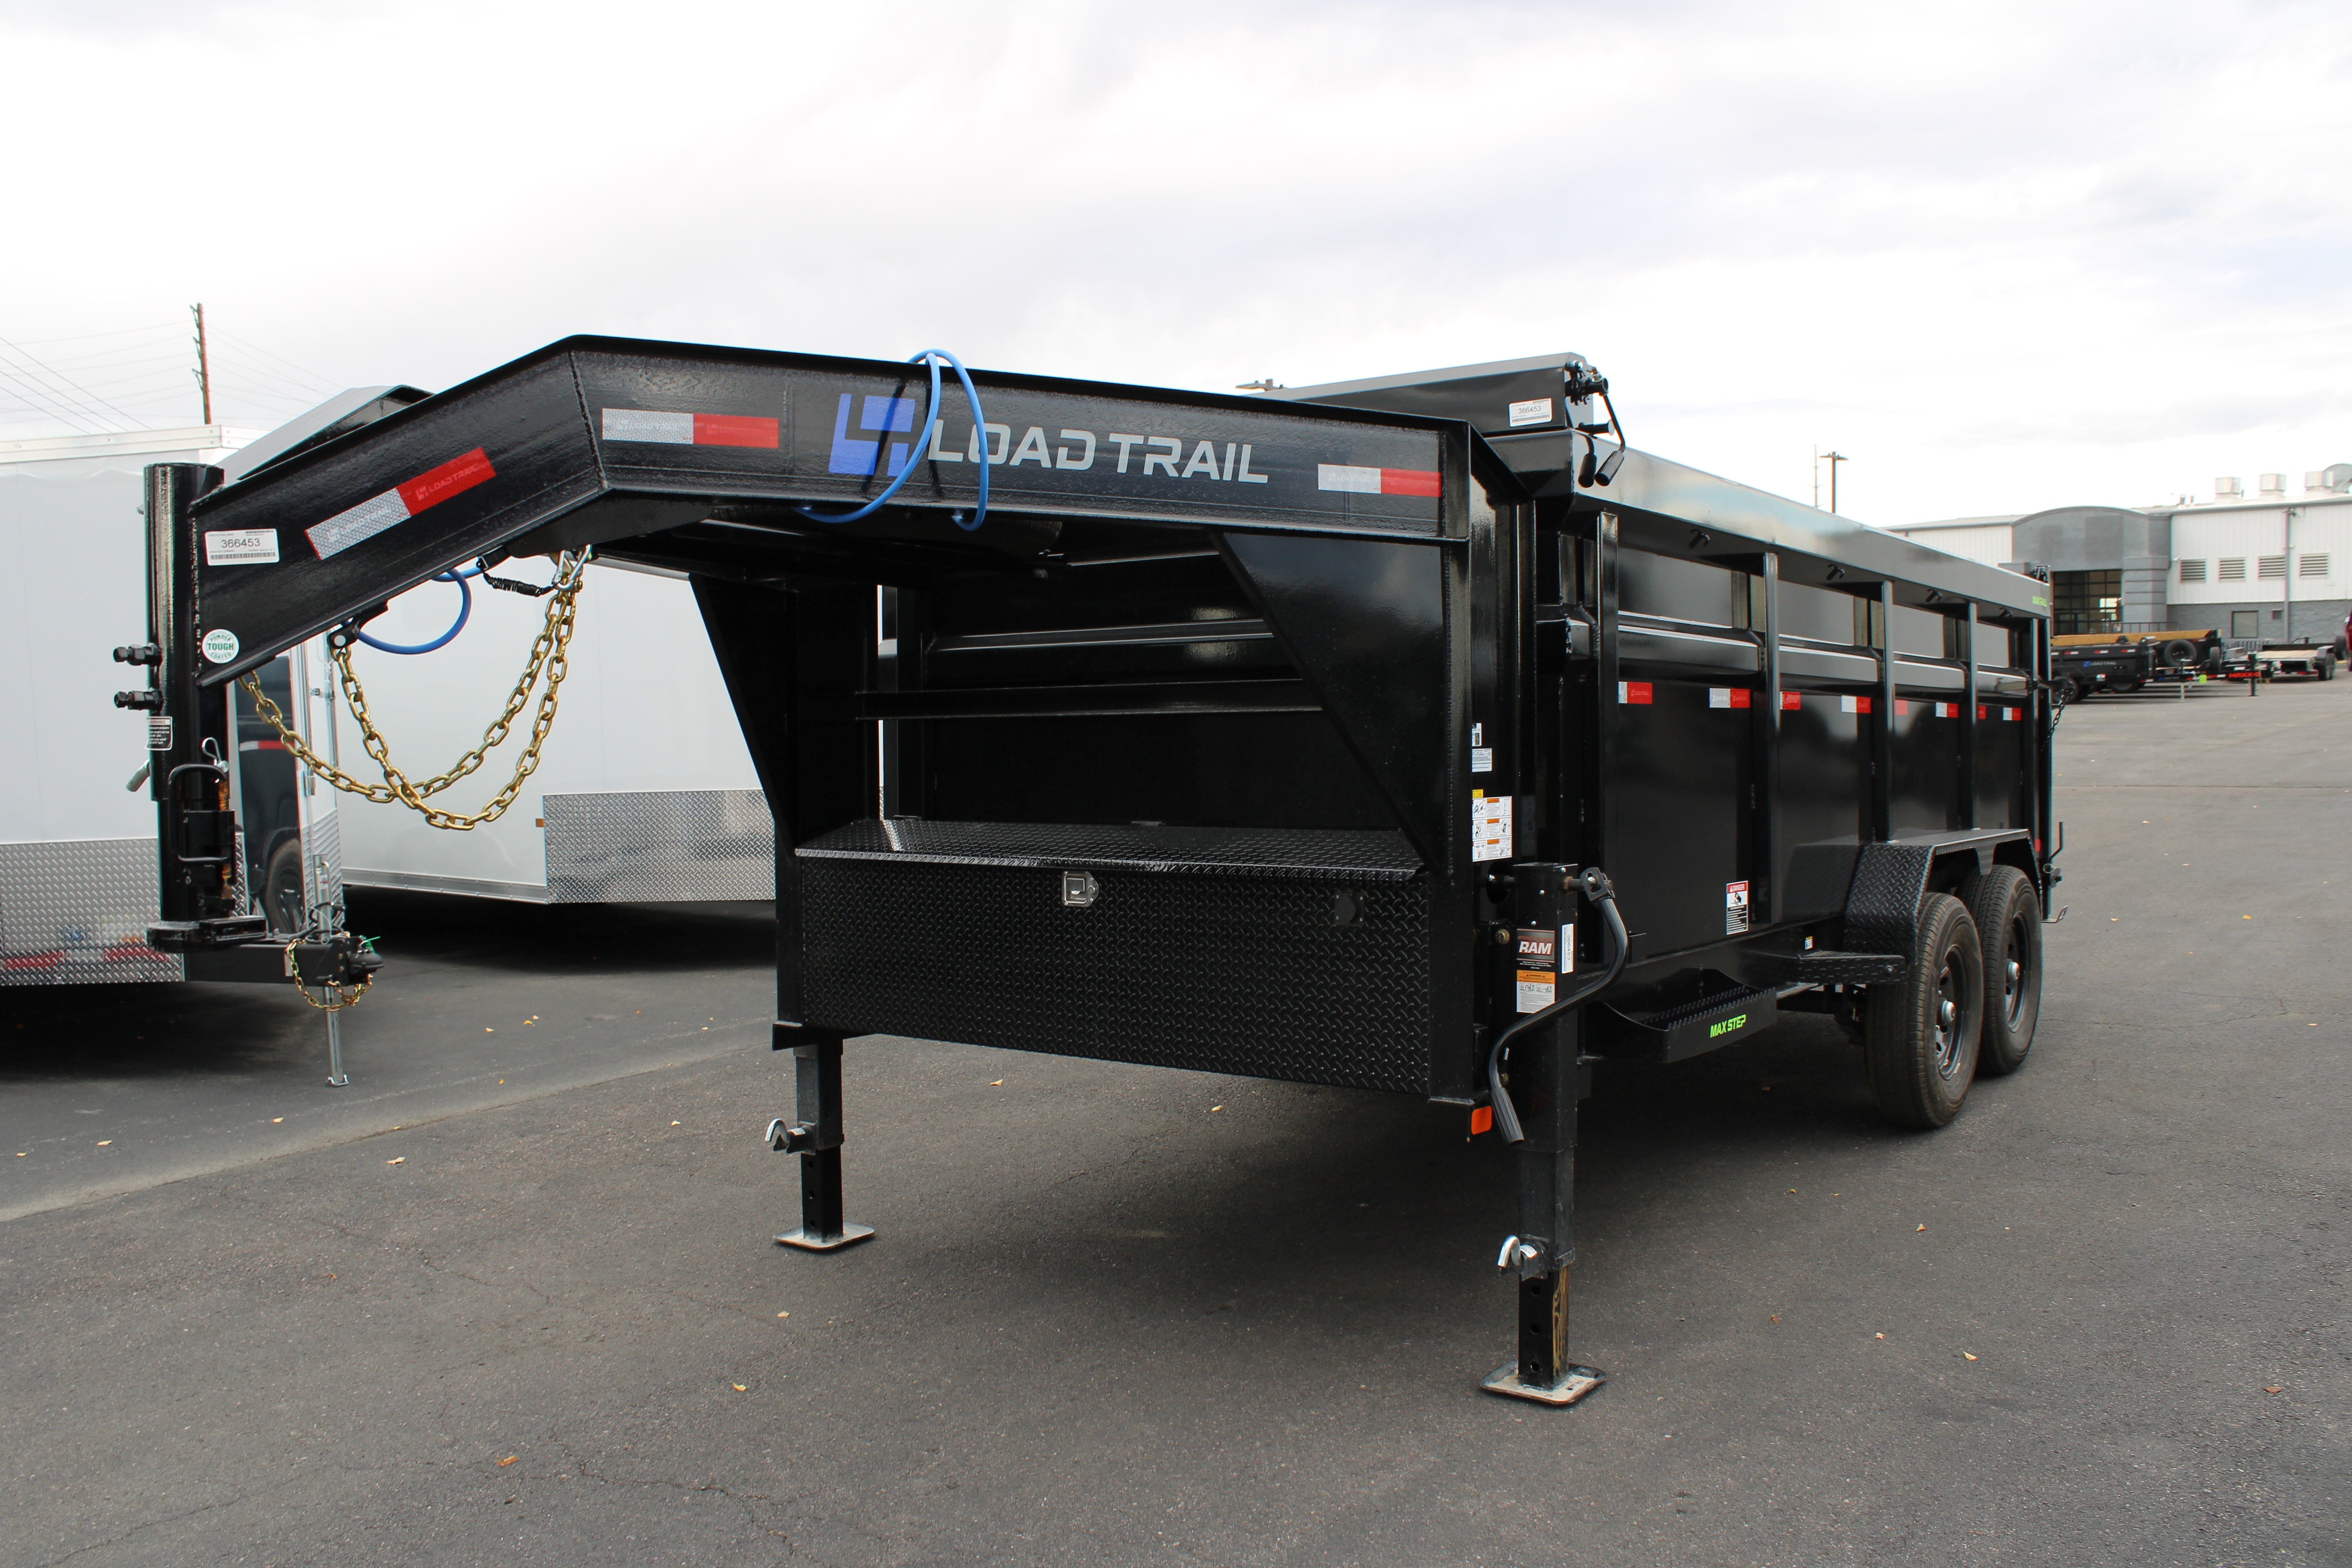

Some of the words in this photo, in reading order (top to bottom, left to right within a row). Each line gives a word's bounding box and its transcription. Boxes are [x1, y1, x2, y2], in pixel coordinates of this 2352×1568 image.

[928, 419, 1096, 470] LOAD
[1109, 433, 1269, 484] TRAIL
[429, 477, 452, 492] LOAD
[221, 538, 261, 548] 366453
[1519, 941, 1553, 955] RAM
[1710, 1021, 1727, 1038] MAX
[1727, 1014, 1746, 1031] STEP
